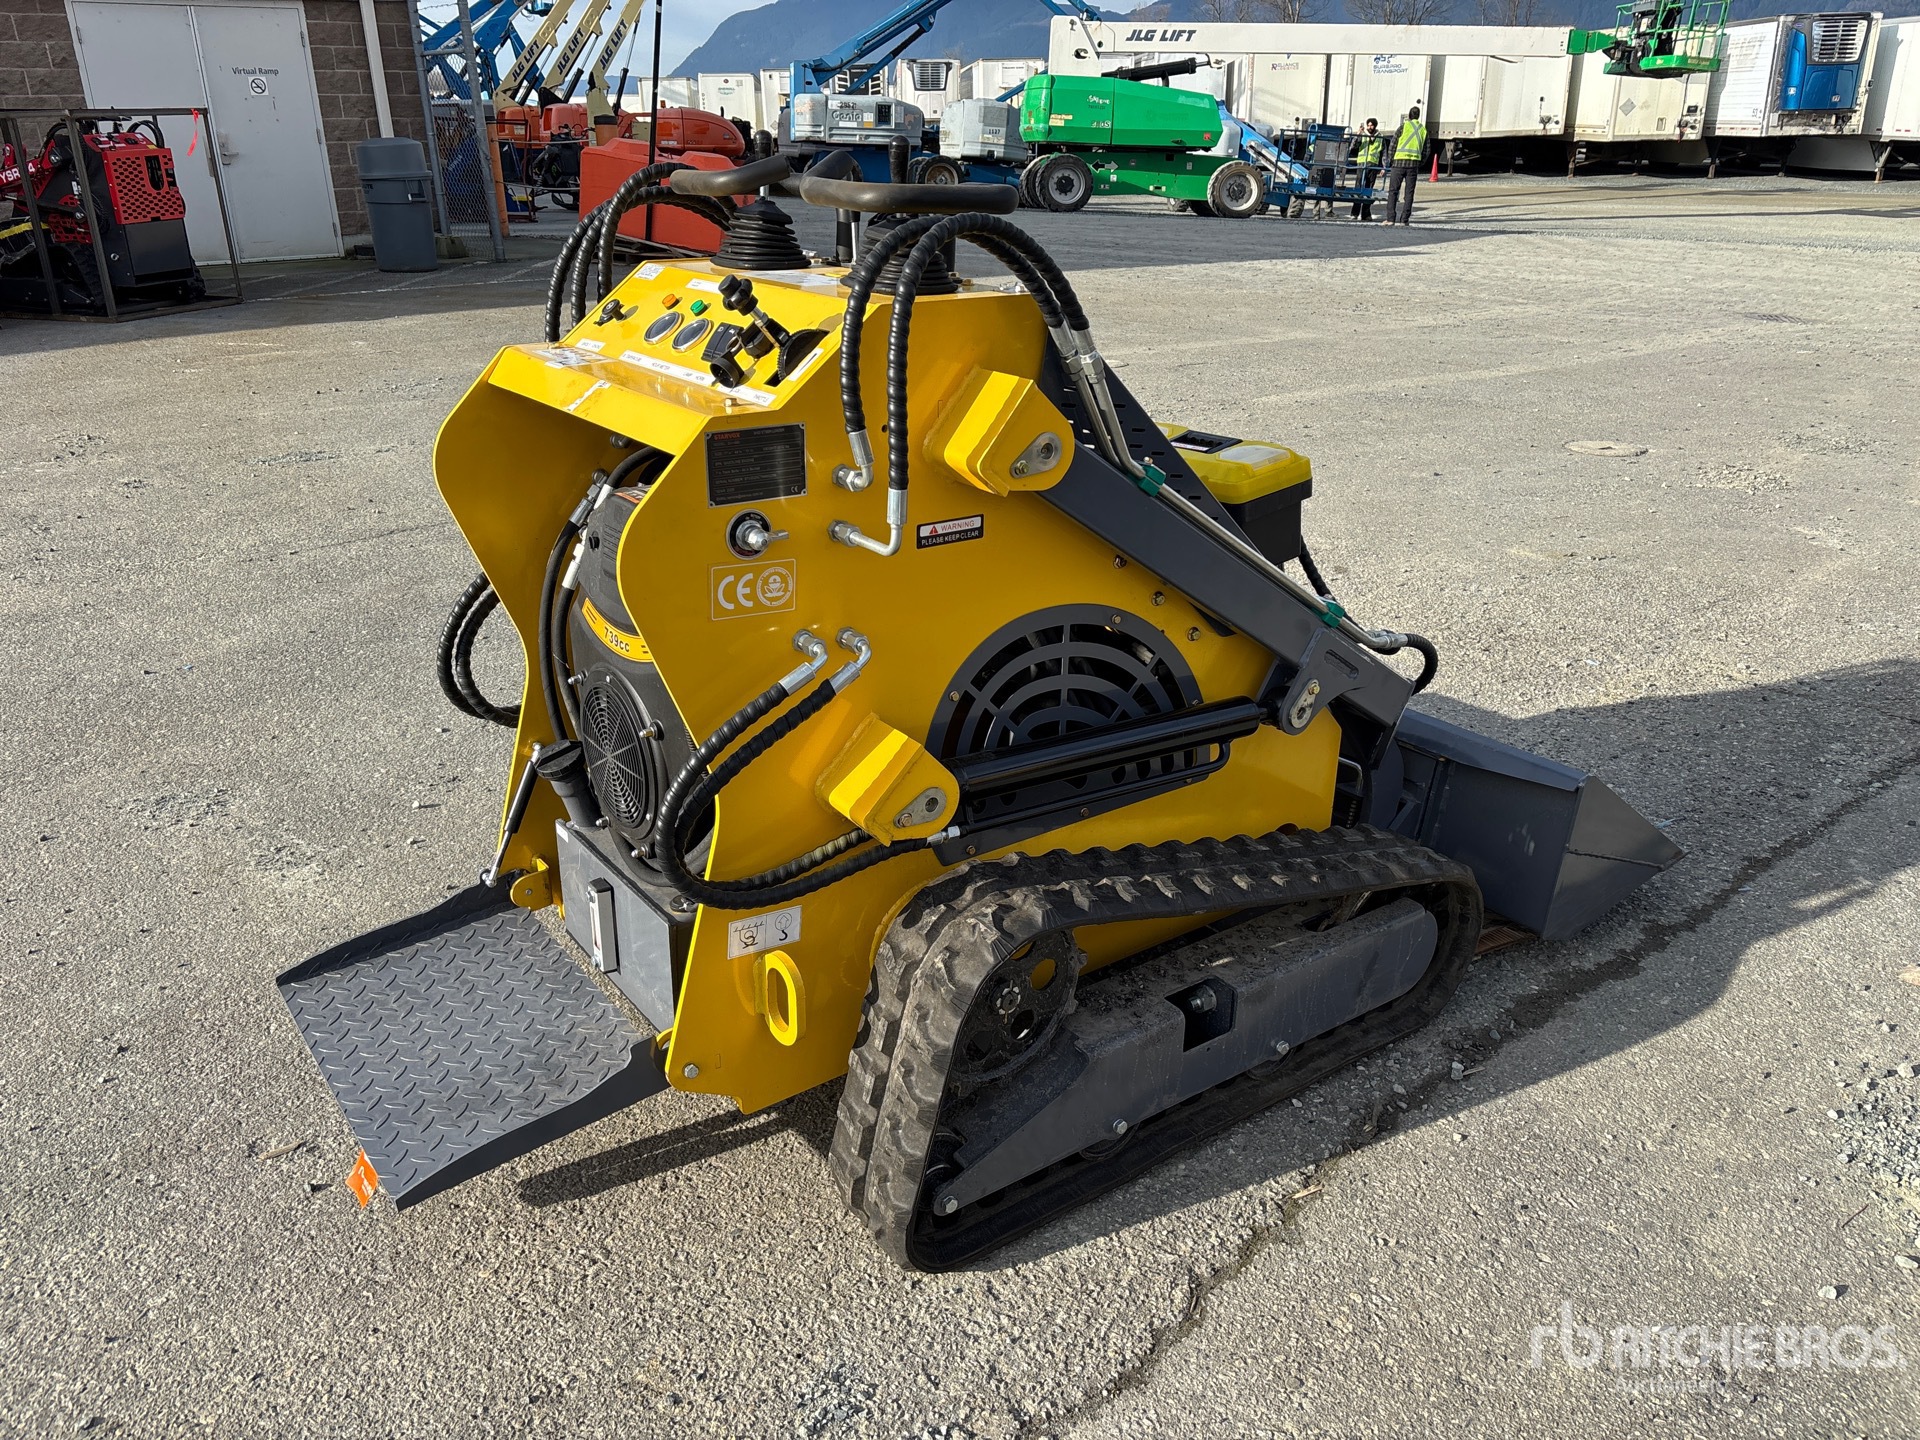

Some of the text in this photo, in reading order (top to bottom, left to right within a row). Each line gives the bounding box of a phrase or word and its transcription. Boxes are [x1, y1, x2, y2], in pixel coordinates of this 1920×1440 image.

[599, 18, 628, 70] JLG LIFT
[1125, 29, 1197, 42] JLG LIFT
[512, 40, 540, 82] JLG LIFT
[556, 27, 585, 75] JLG LIFT
[231, 66, 280, 77] Virtual Ramp
[831, 109, 862, 122] Genie
[941, 520, 975, 532] WARNING
[921, 530, 979, 546] PLEASE KEEP CLEAR
[717, 572, 754, 610] CE
[604, 625, 630, 653] 739cc
